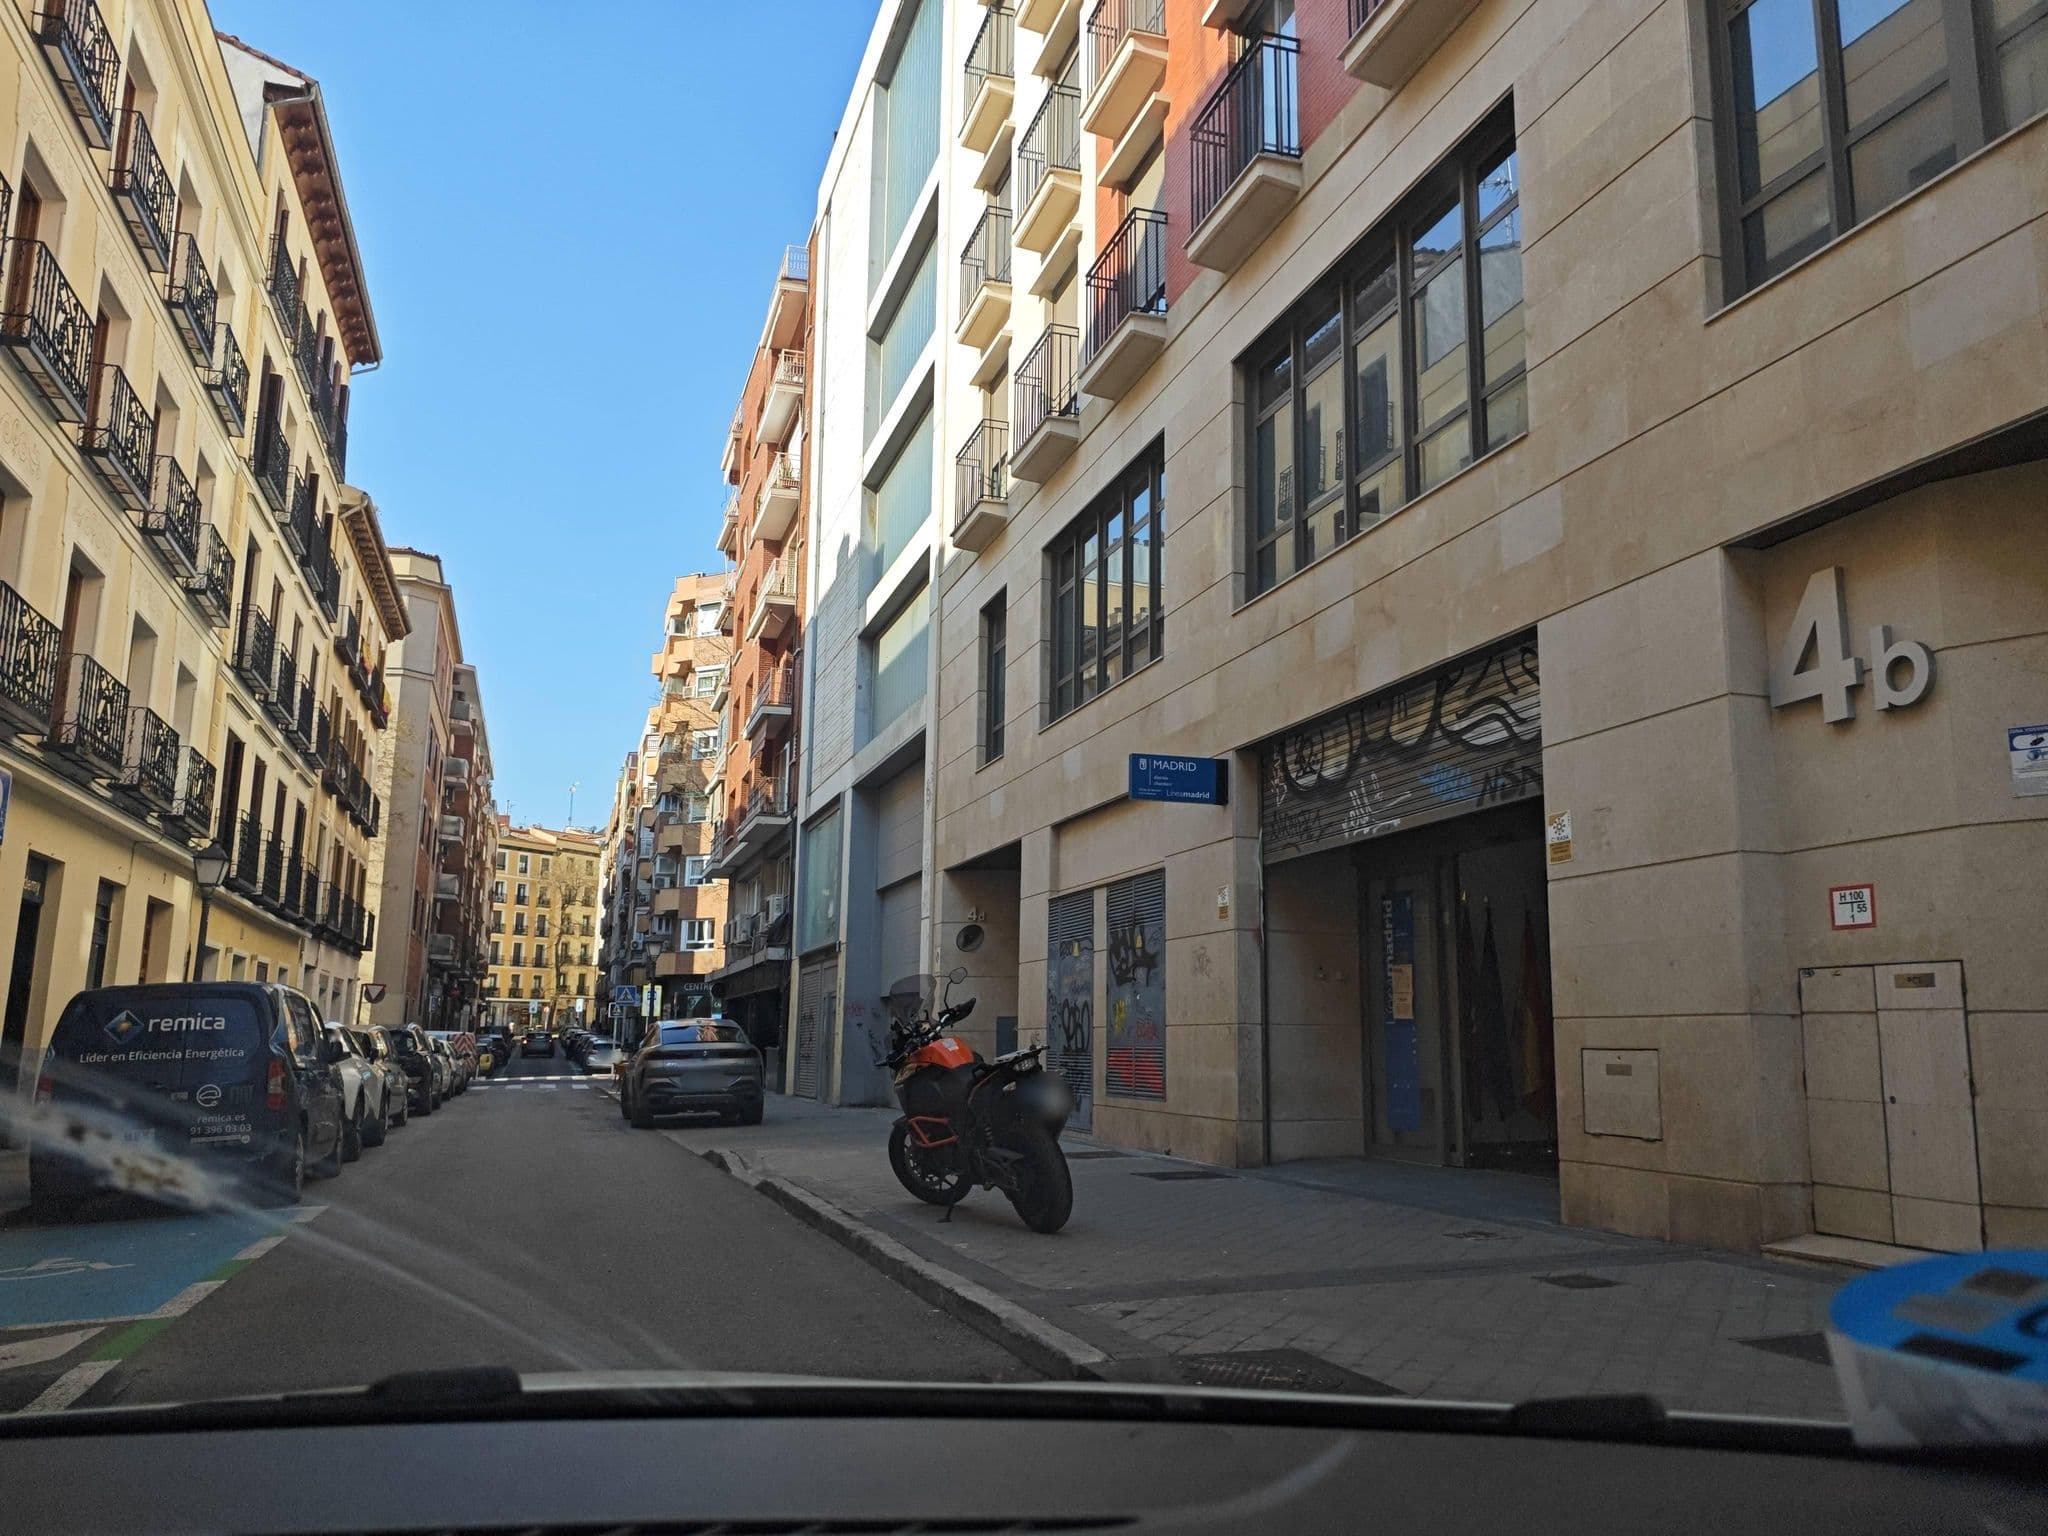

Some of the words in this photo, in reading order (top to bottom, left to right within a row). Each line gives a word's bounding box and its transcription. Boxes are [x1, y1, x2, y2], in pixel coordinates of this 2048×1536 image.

[1153, 760, 1197, 772] MADRID
[1848, 890, 1864, 900] 100
[1856, 903, 1867, 913] 55
[148, 1012, 226, 1033] remica
[79, 1053, 108, 1064] Líder
[111, 1054, 126, 1062] en
[128, 1050, 182, 1061] Eficiencia
[185, 1047, 245, 1061] Energética
